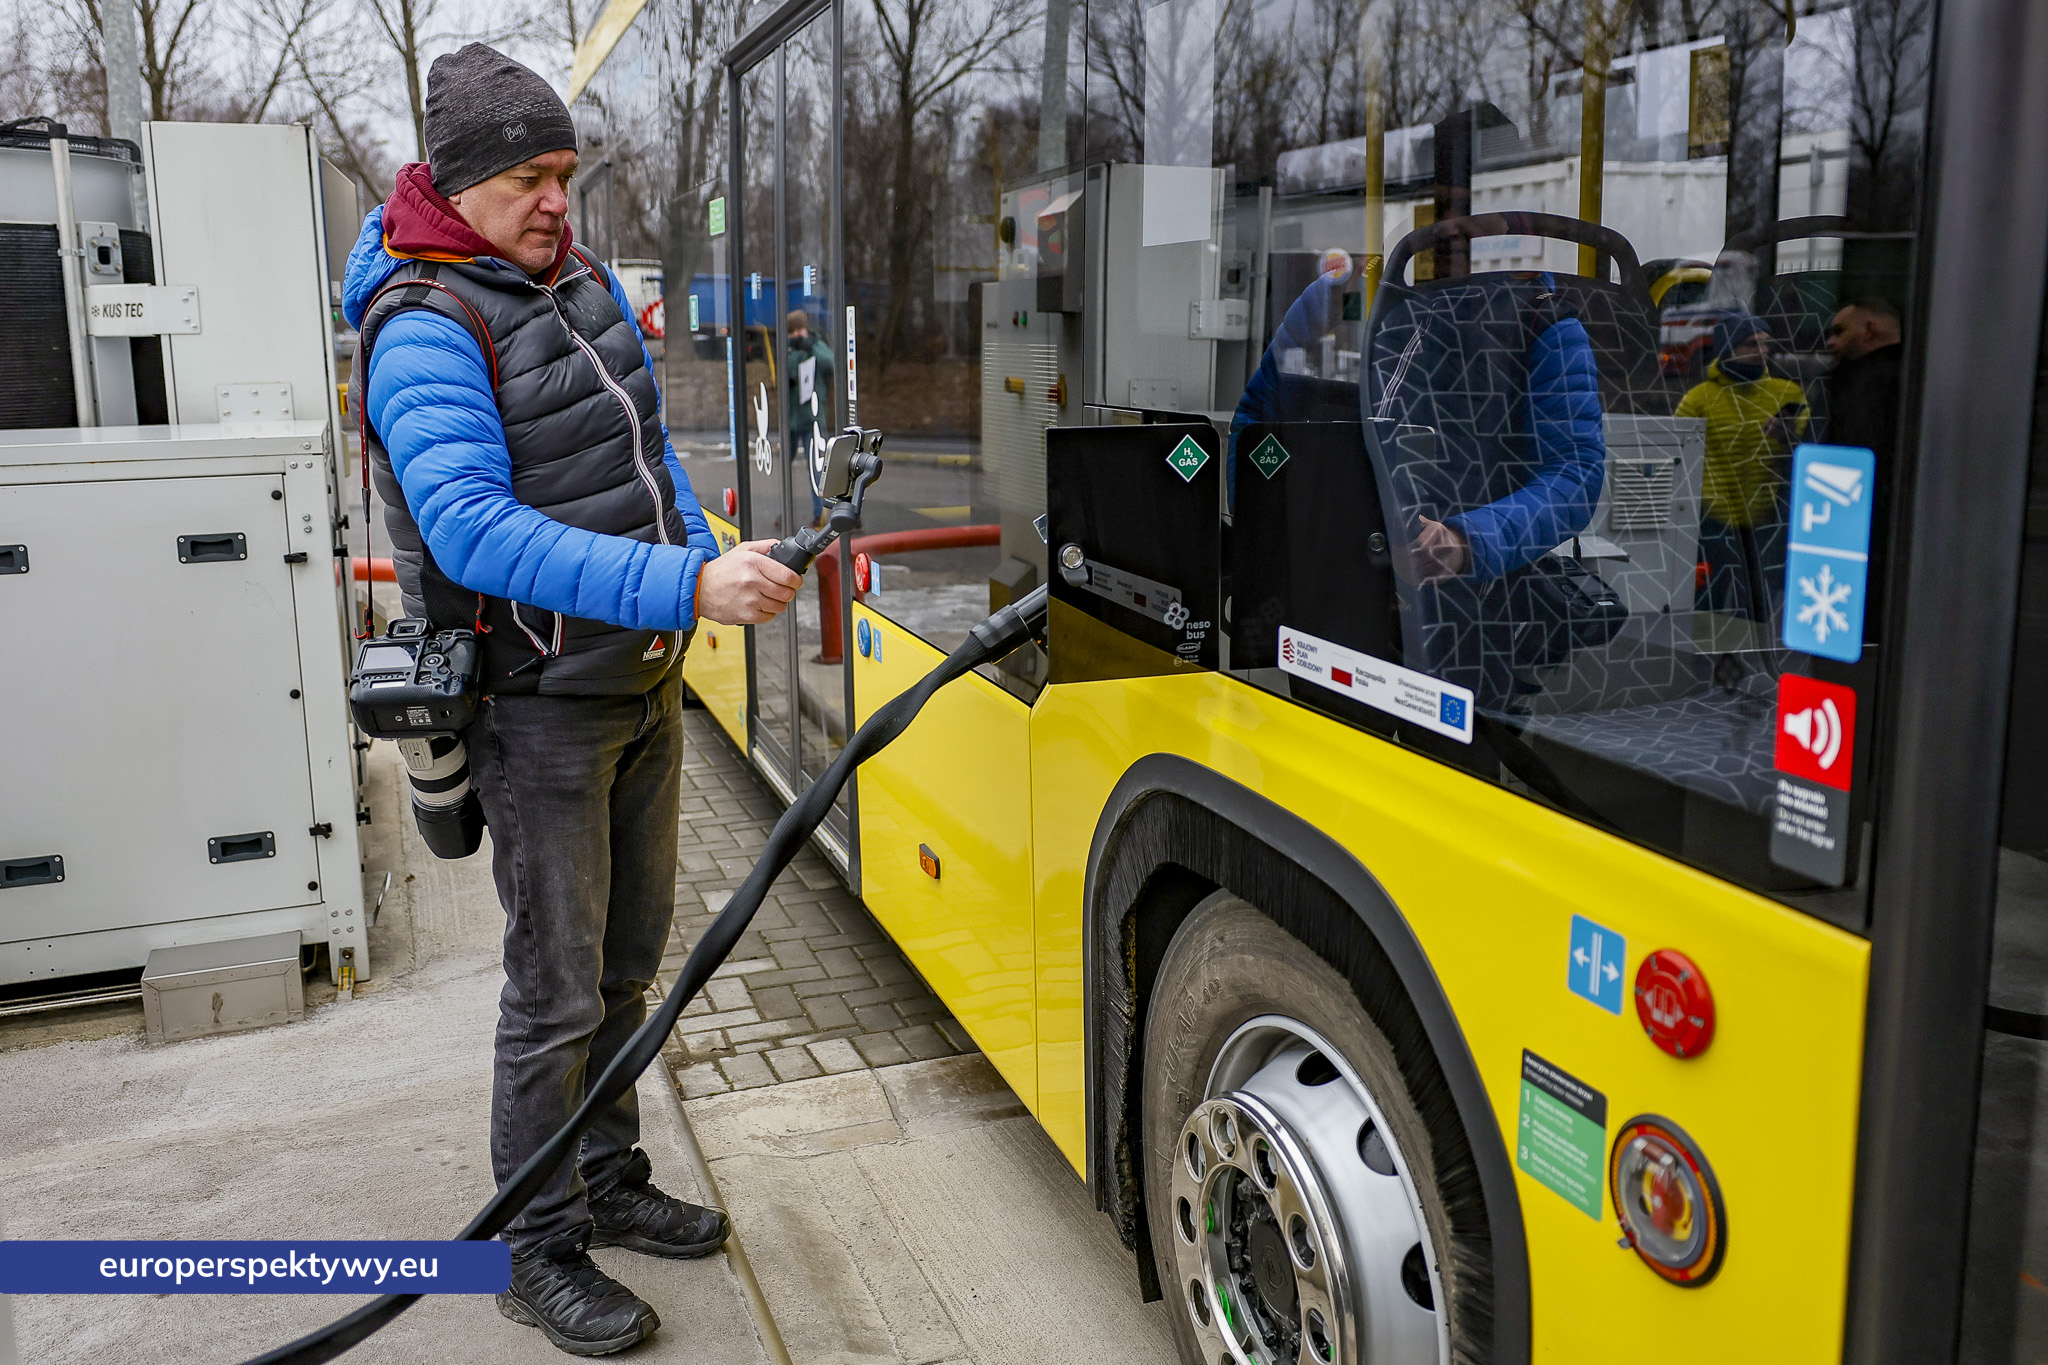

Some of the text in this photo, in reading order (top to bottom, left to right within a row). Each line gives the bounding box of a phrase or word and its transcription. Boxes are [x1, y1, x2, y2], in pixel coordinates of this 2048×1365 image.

[102, 302, 144, 318] KUS TEC
[1178, 457, 1199, 467] GAS
[1186, 620, 1211, 630] neso
[1186, 630, 1206, 640] bus
[1524, 1088, 1531, 1103] 1
[1521, 1112, 1531, 1129] 2
[1520, 1143, 1529, 1161] 3
